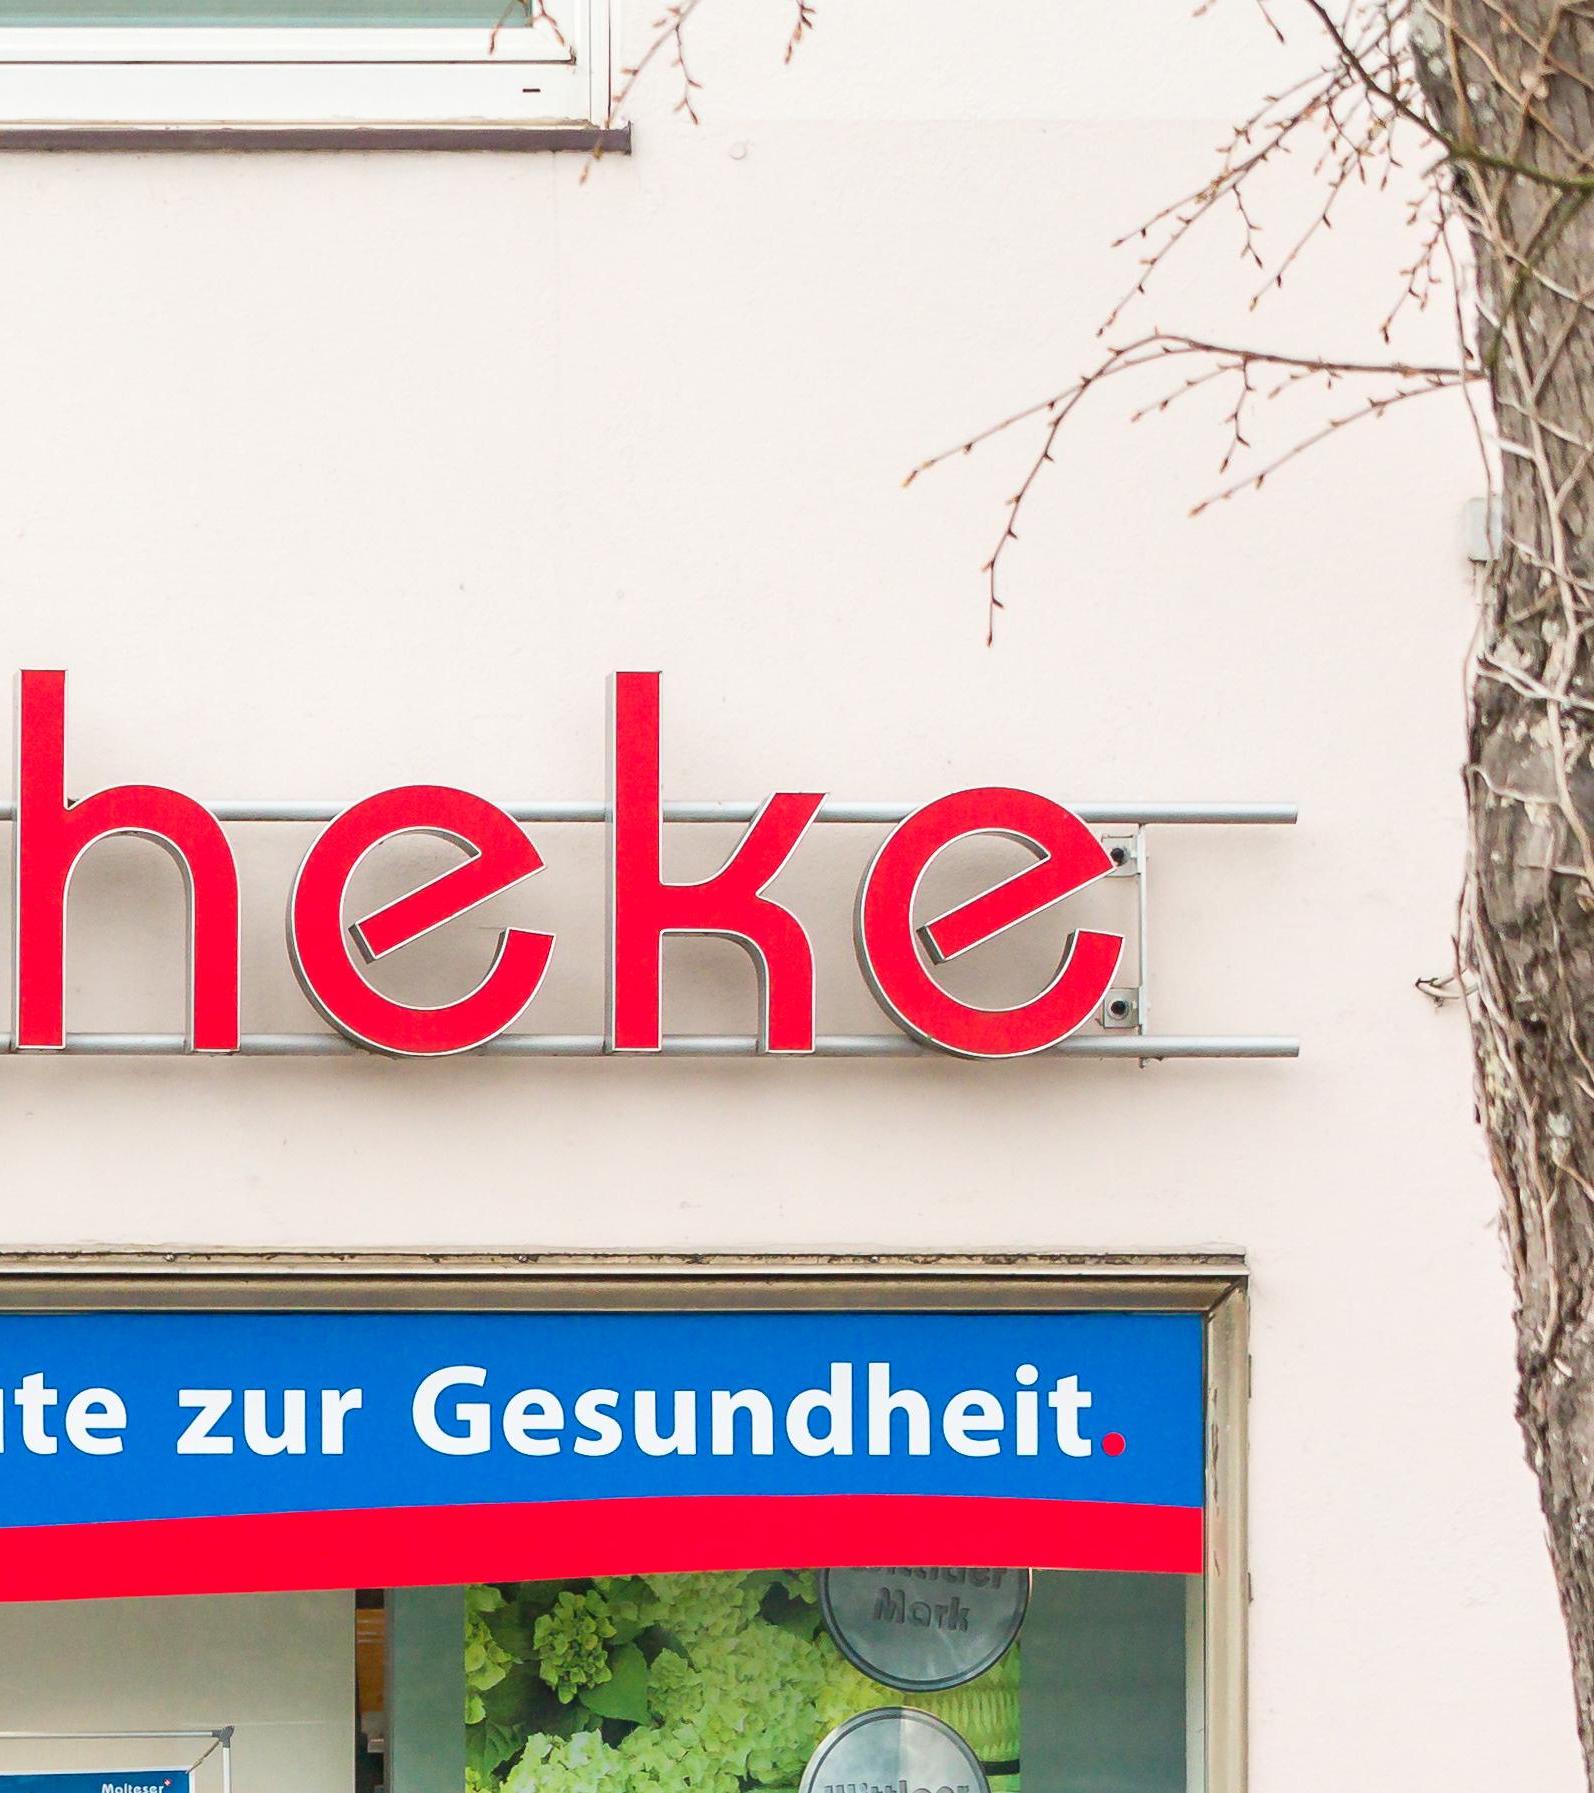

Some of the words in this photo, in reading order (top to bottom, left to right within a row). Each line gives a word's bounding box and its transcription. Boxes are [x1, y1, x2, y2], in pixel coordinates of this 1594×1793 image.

[177, 1386, 363, 1457] zur
[413, 1360, 1127, 1458] Gesundheit.
[872, 1586, 971, 1634] Mark
